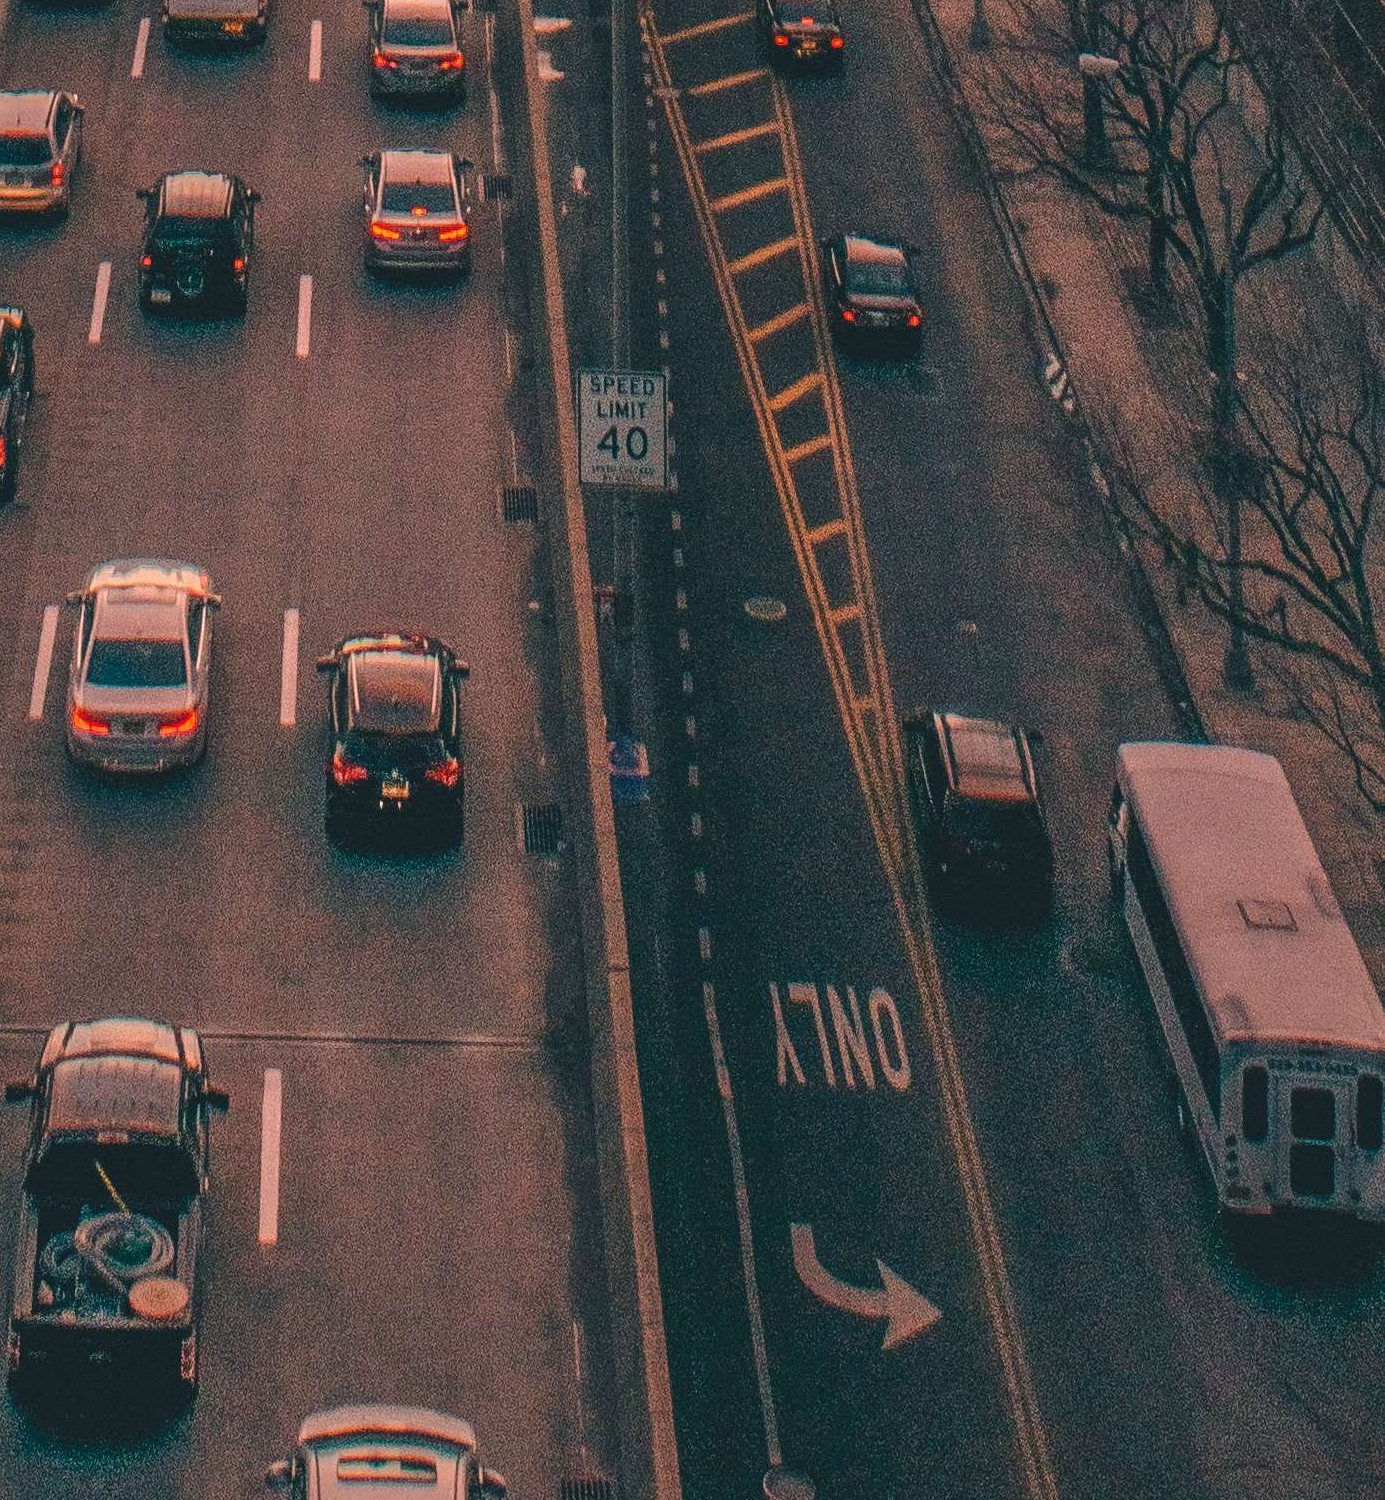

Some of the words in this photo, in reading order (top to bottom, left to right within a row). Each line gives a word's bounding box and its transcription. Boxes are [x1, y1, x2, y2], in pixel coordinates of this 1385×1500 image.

[590, 375, 655, 396] SPEED
[597, 401, 649, 419] LIMIT
[597, 425, 649, 461] 40
[768, 980, 912, 1093] ONLY
